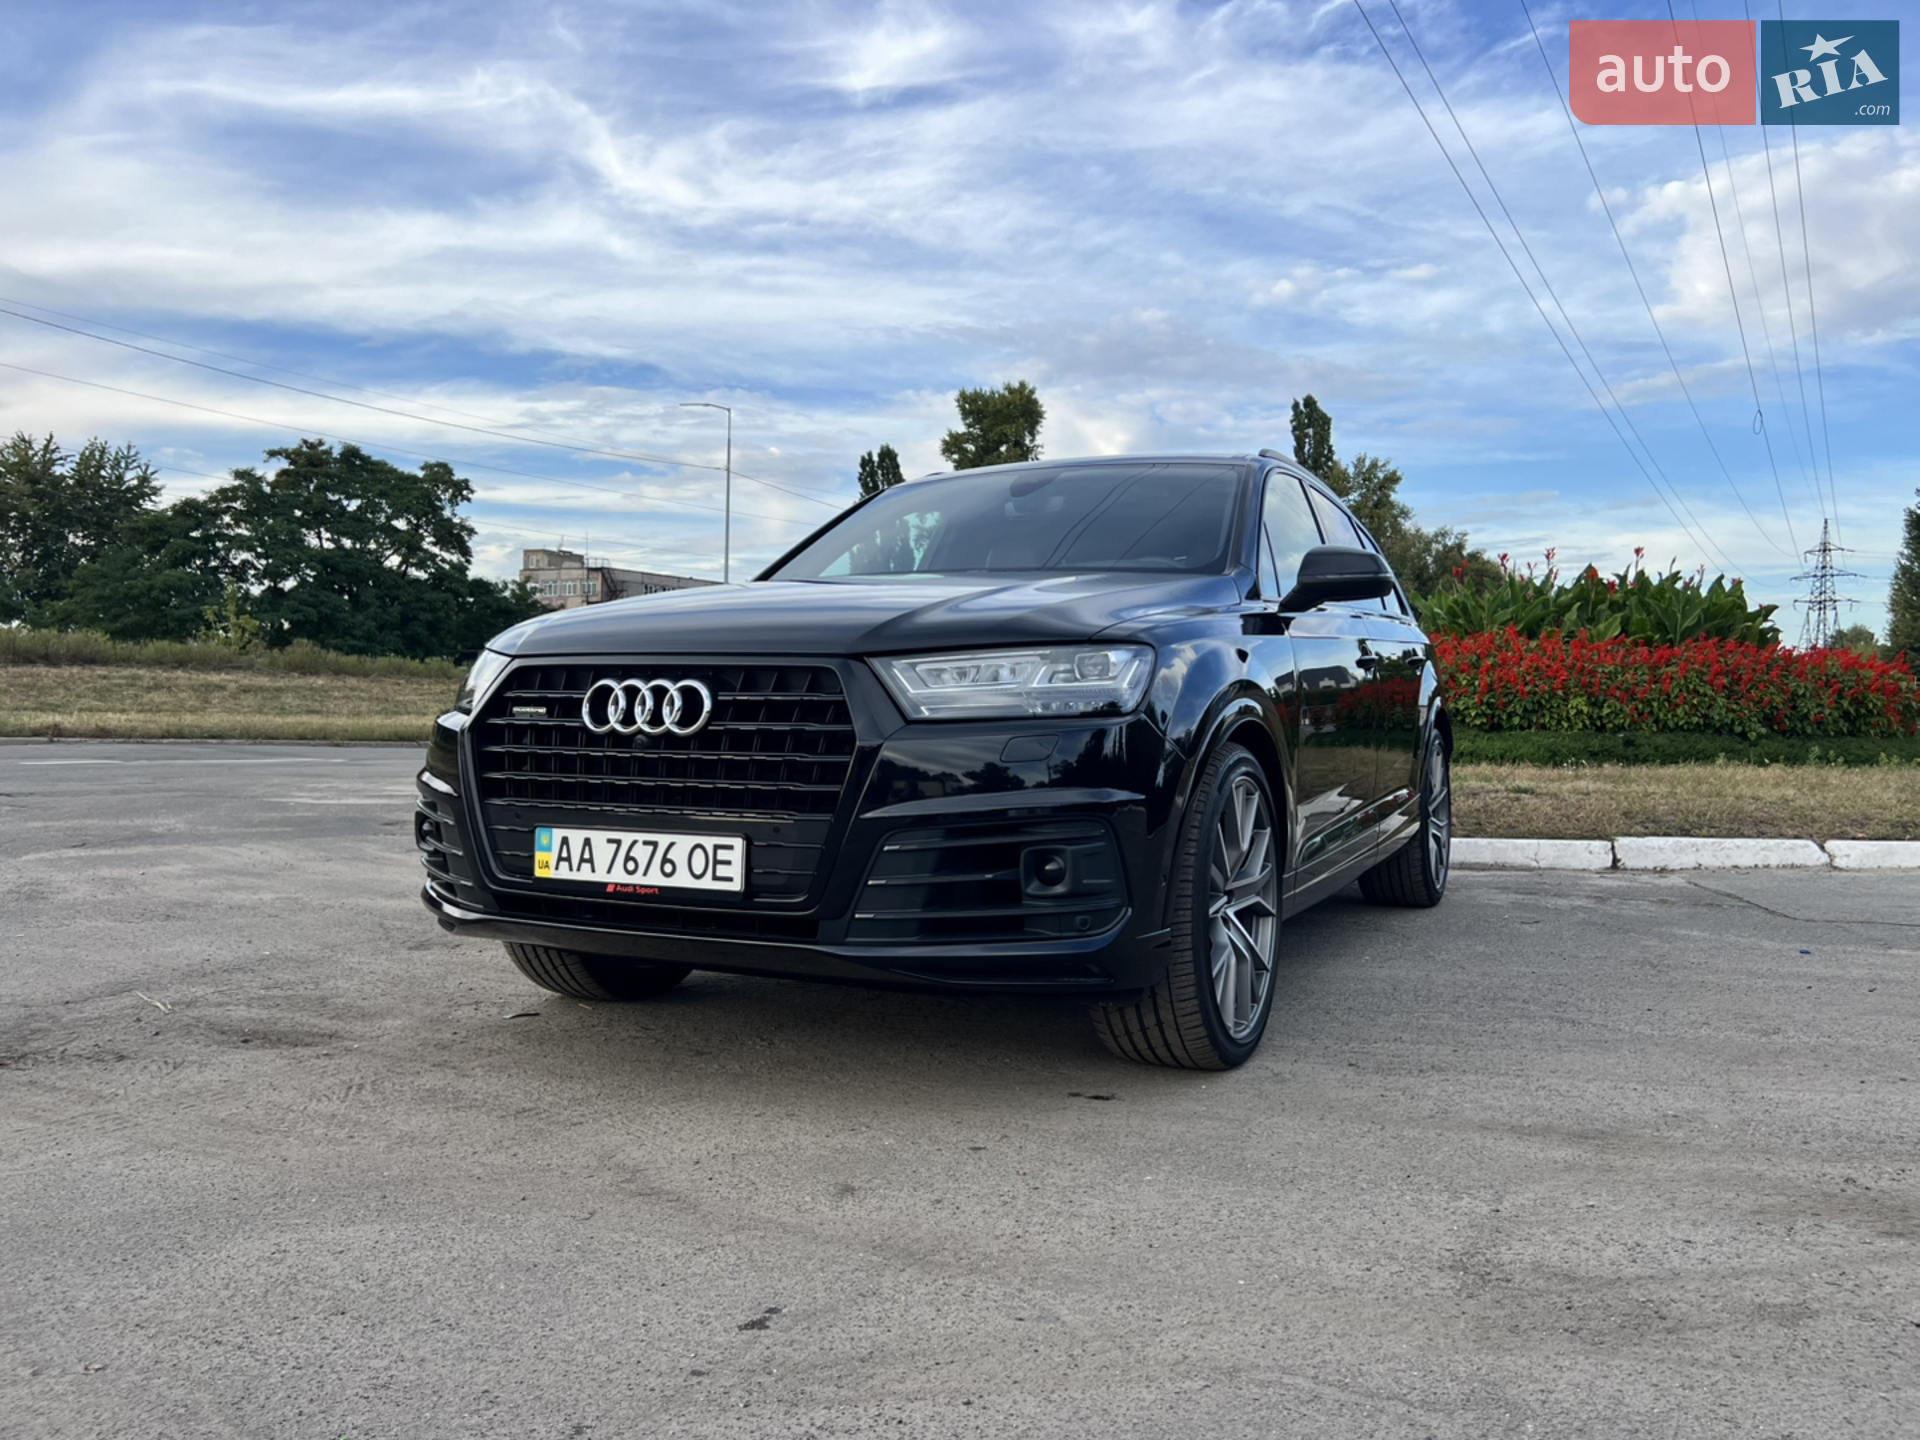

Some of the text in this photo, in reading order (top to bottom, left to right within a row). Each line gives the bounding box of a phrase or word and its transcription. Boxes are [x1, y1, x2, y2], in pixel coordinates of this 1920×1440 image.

[538, 859, 550, 870] UA
[554, 836, 735, 882] AA 7676 OE
[616, 884, 659, 895] Audi Sport
